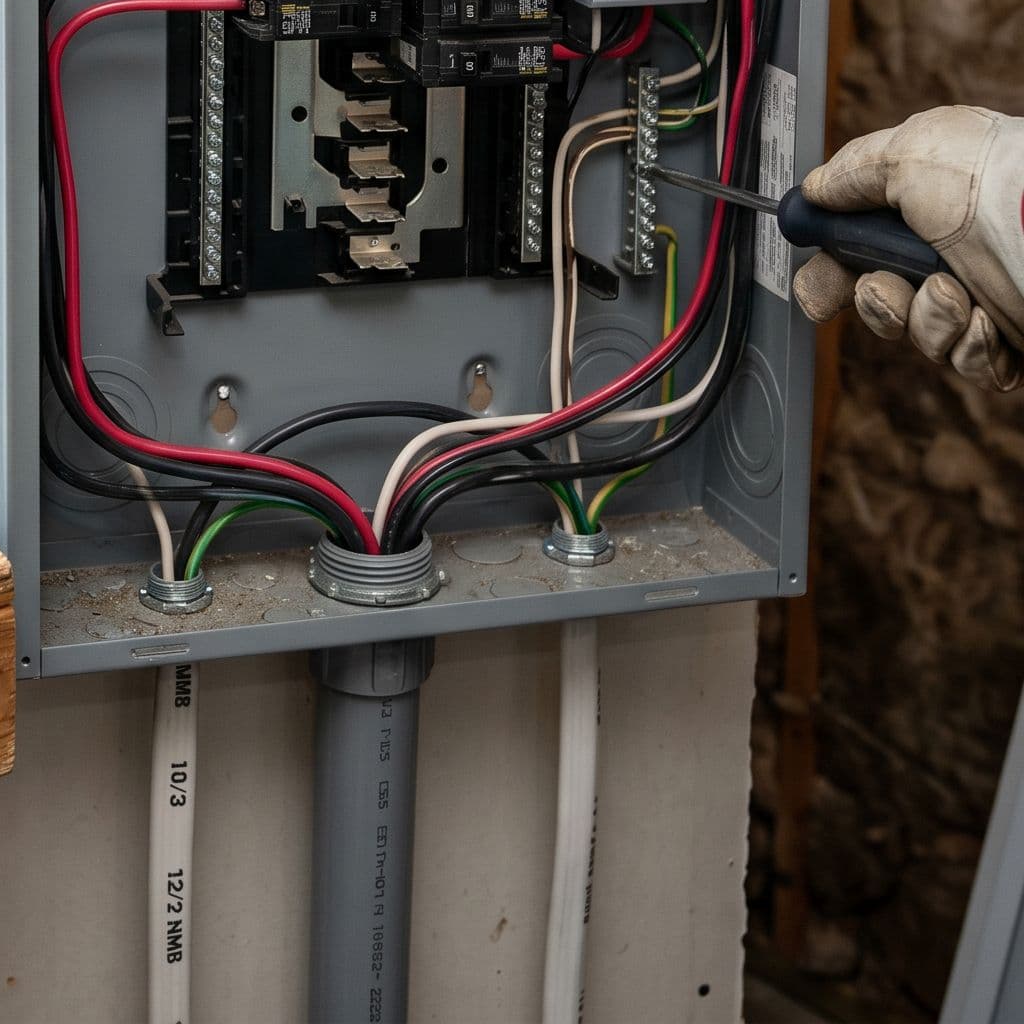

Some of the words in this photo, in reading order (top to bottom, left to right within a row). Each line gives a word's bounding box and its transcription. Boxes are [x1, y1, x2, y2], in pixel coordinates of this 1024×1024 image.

[170, 761, 187, 808] 10/3
[167, 869, 183, 914] 12/2
[166, 920, 183, 965] NMB
